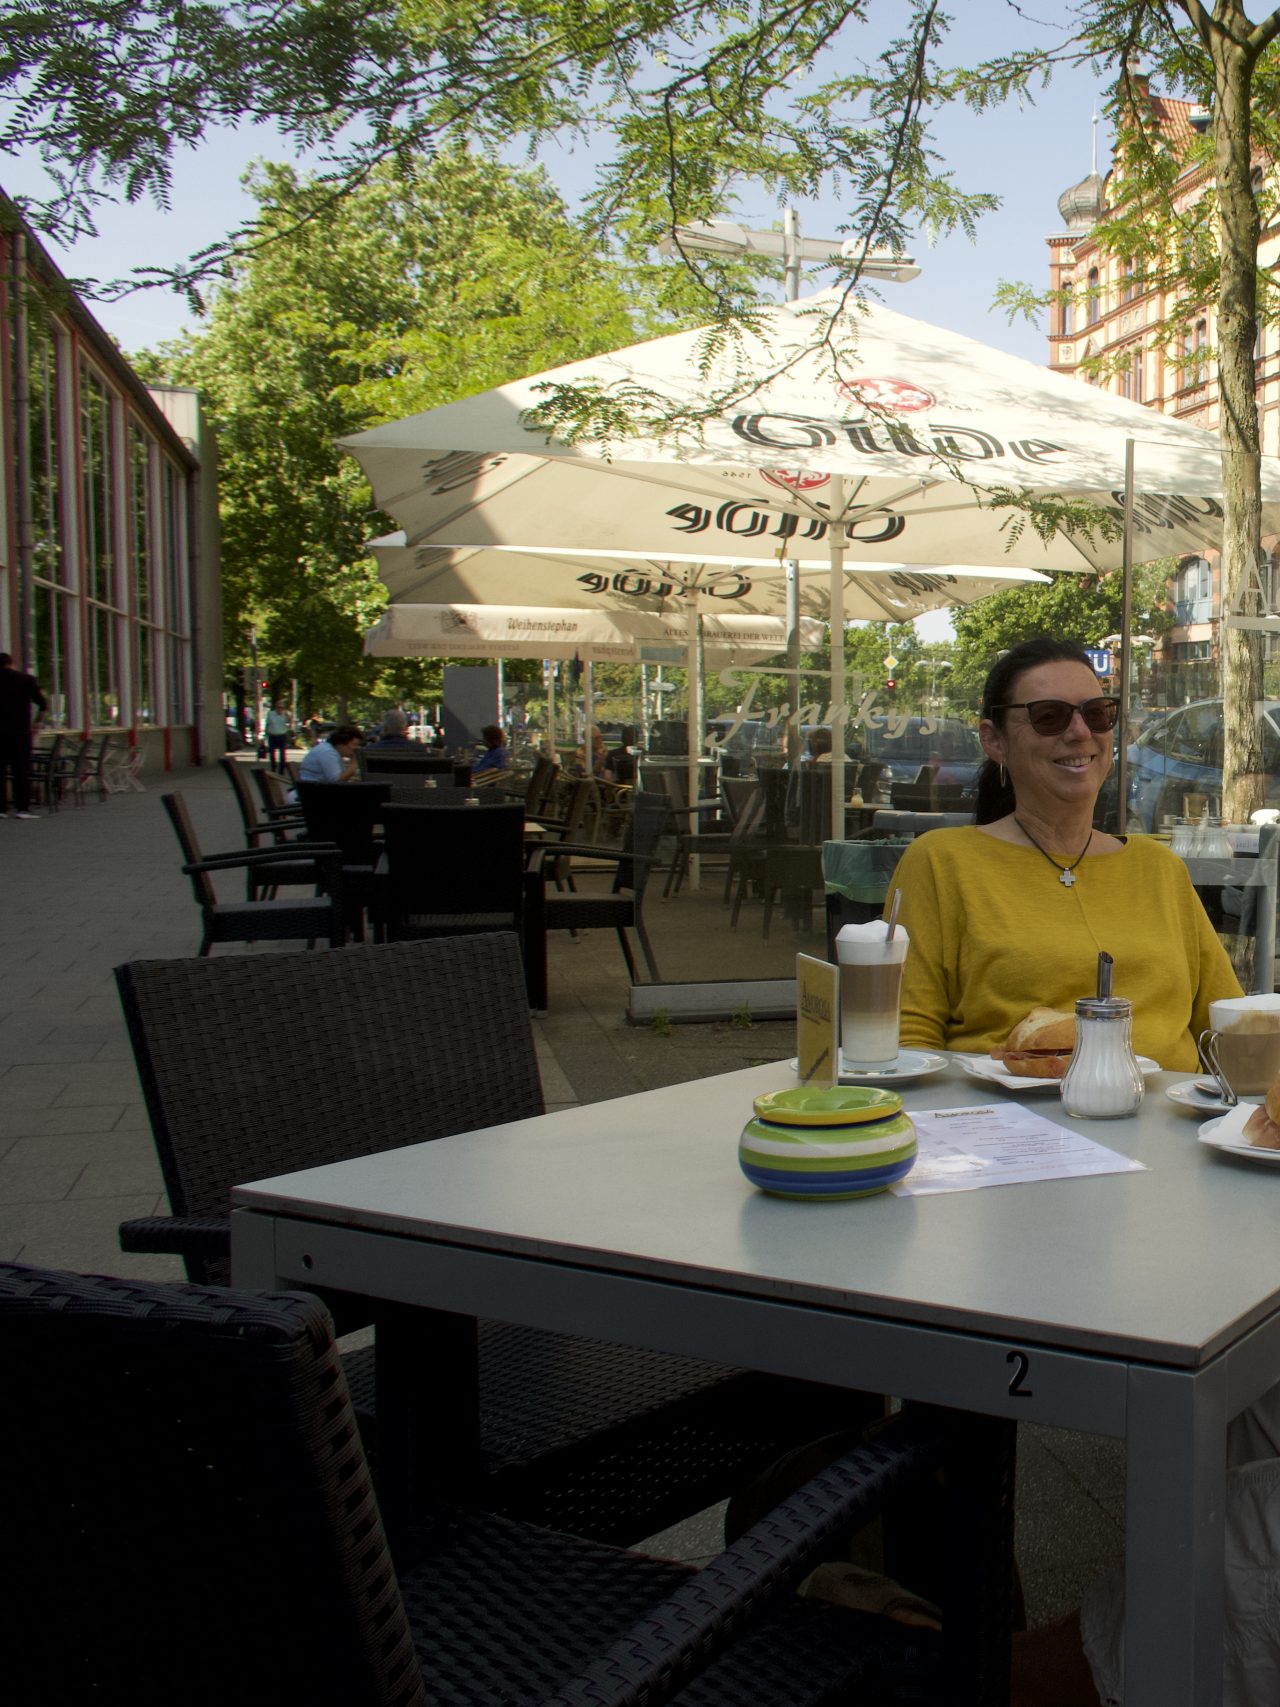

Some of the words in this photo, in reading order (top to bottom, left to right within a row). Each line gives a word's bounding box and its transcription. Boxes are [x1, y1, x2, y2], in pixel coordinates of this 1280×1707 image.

[507, 617, 578, 632] Weihenstephan
[1093, 653, 1108, 673] U
[1006, 1350, 1032, 1397] 2
